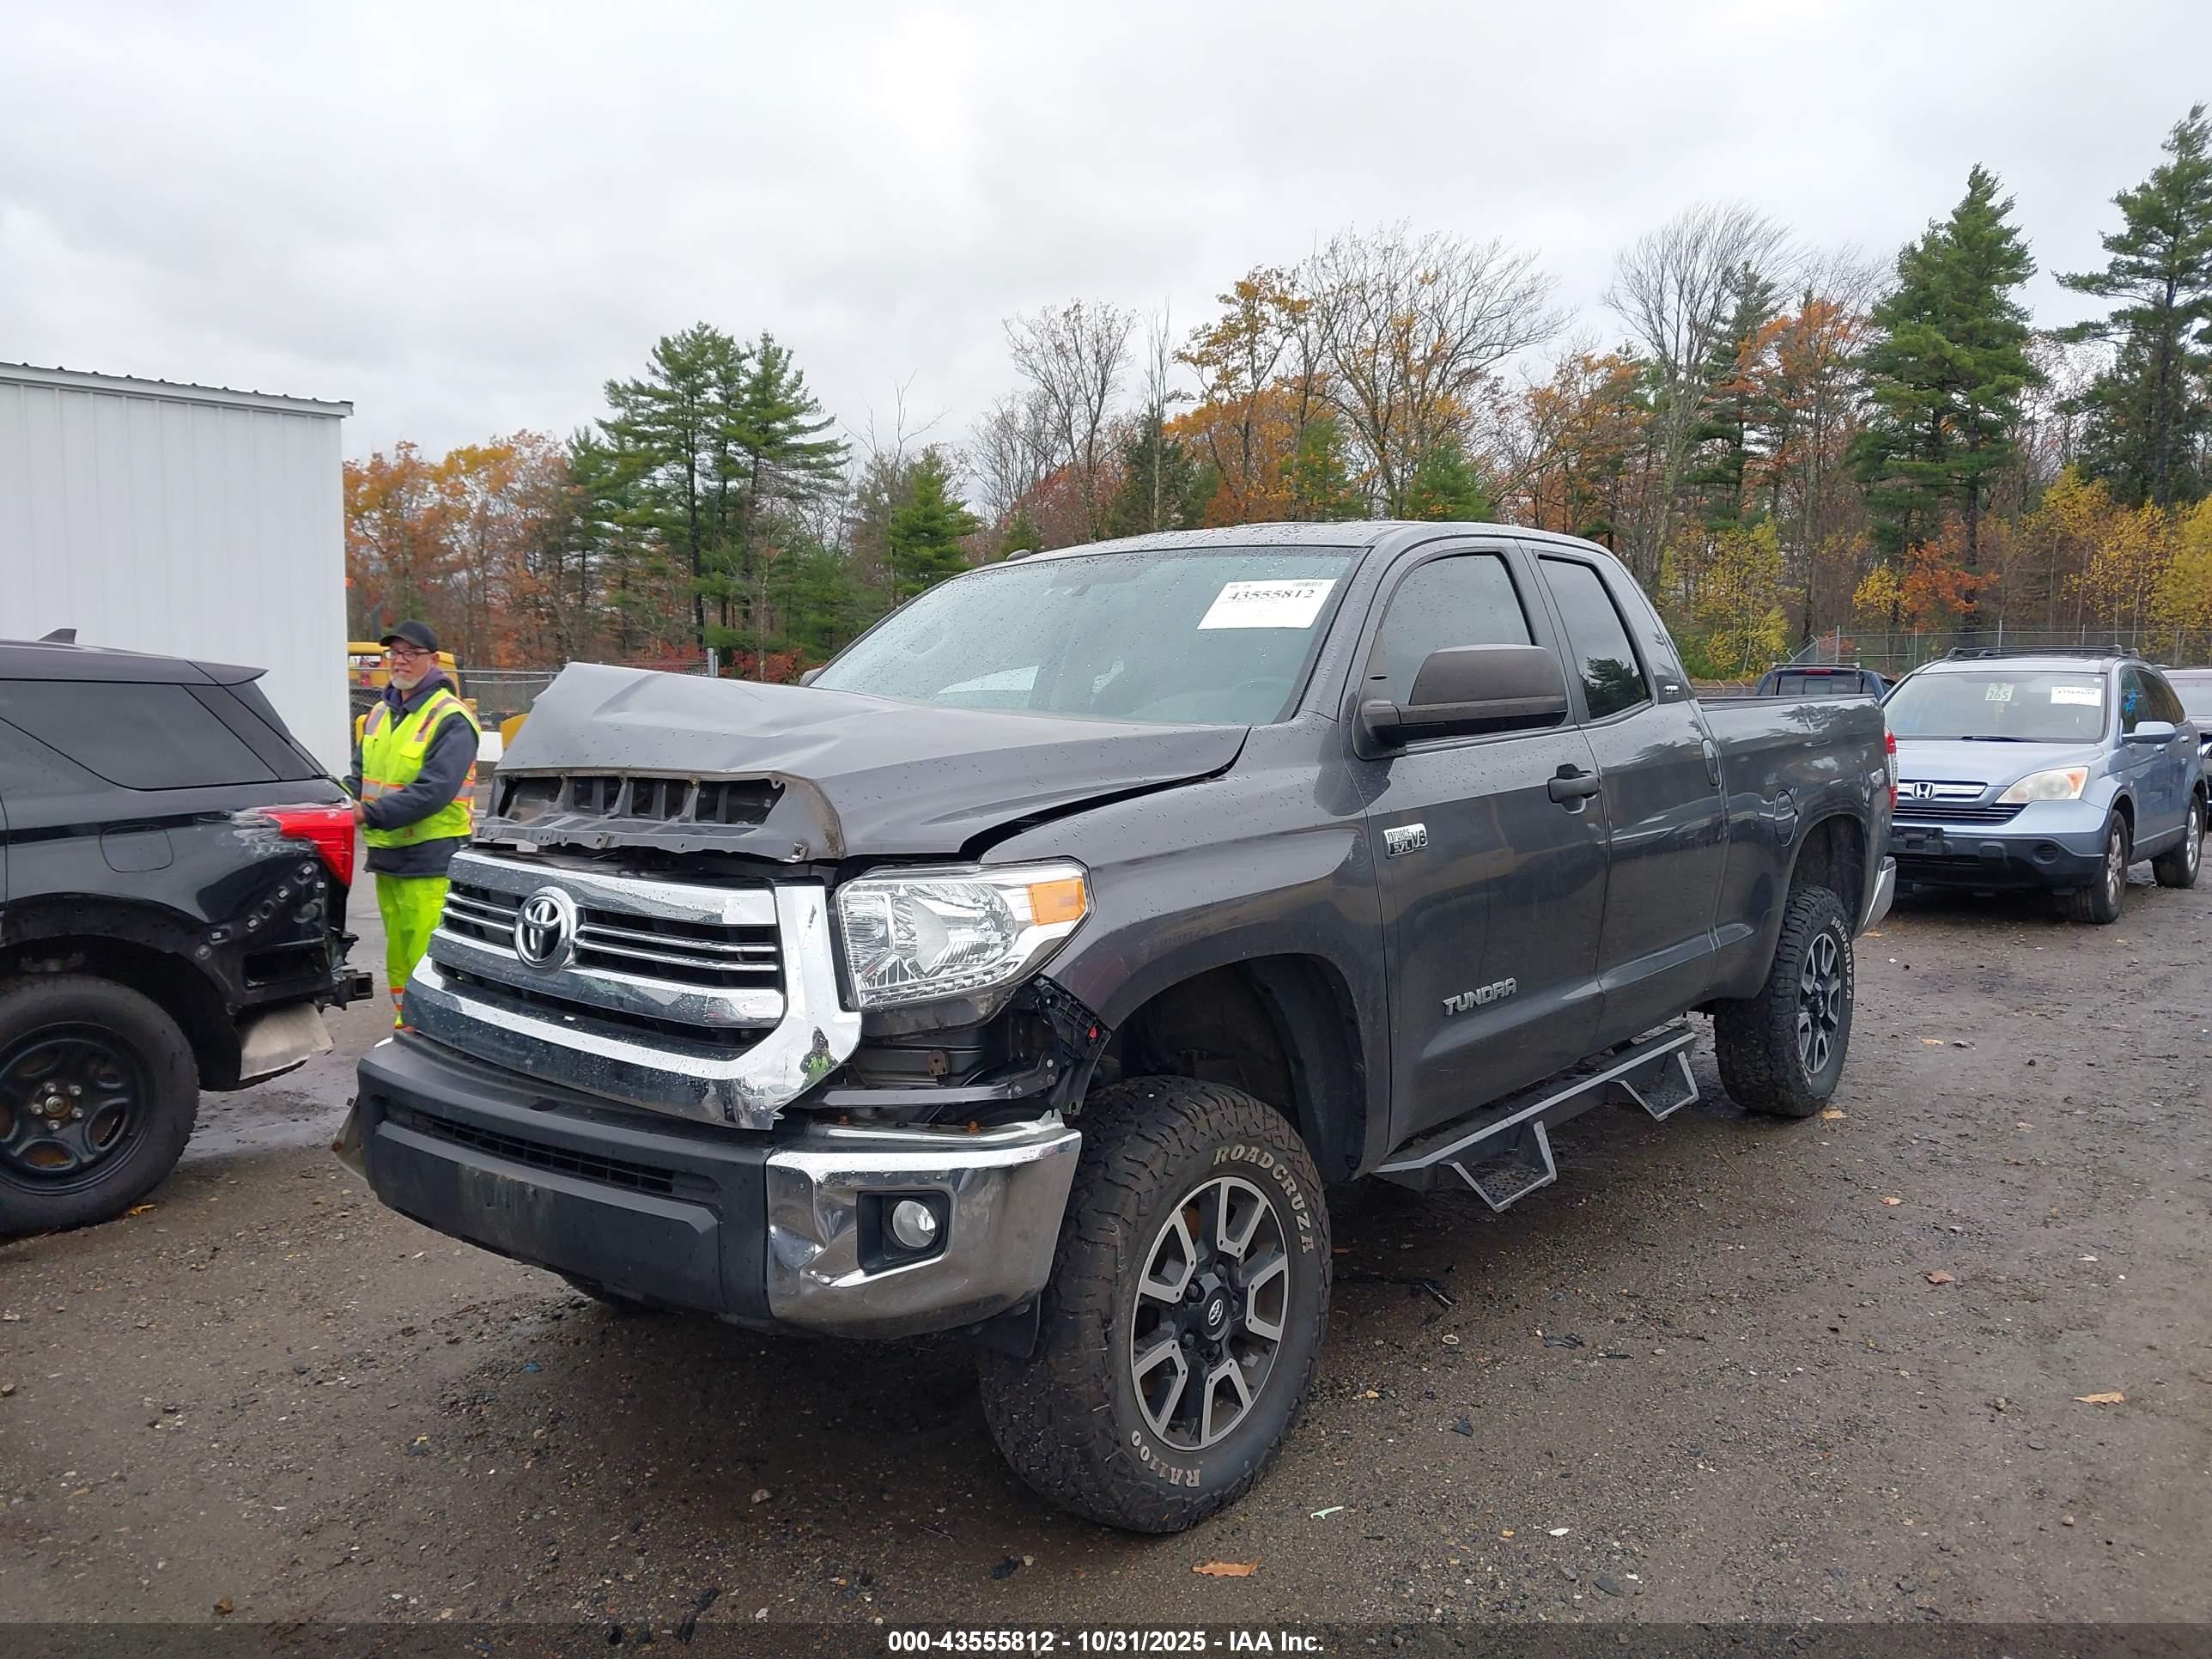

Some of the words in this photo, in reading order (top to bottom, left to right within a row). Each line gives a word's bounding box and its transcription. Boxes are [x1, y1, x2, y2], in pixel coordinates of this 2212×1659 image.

[1229, 588, 1316, 600] 43555812
[1988, 690, 2009, 700] 265
[1413, 830, 1426, 847] V8
[1831, 915, 1852, 1000] ROADCRUZA
[1443, 977, 1517, 1016] TUNDRA
[1212, 1143, 1315, 1254] ROADCRUZA
